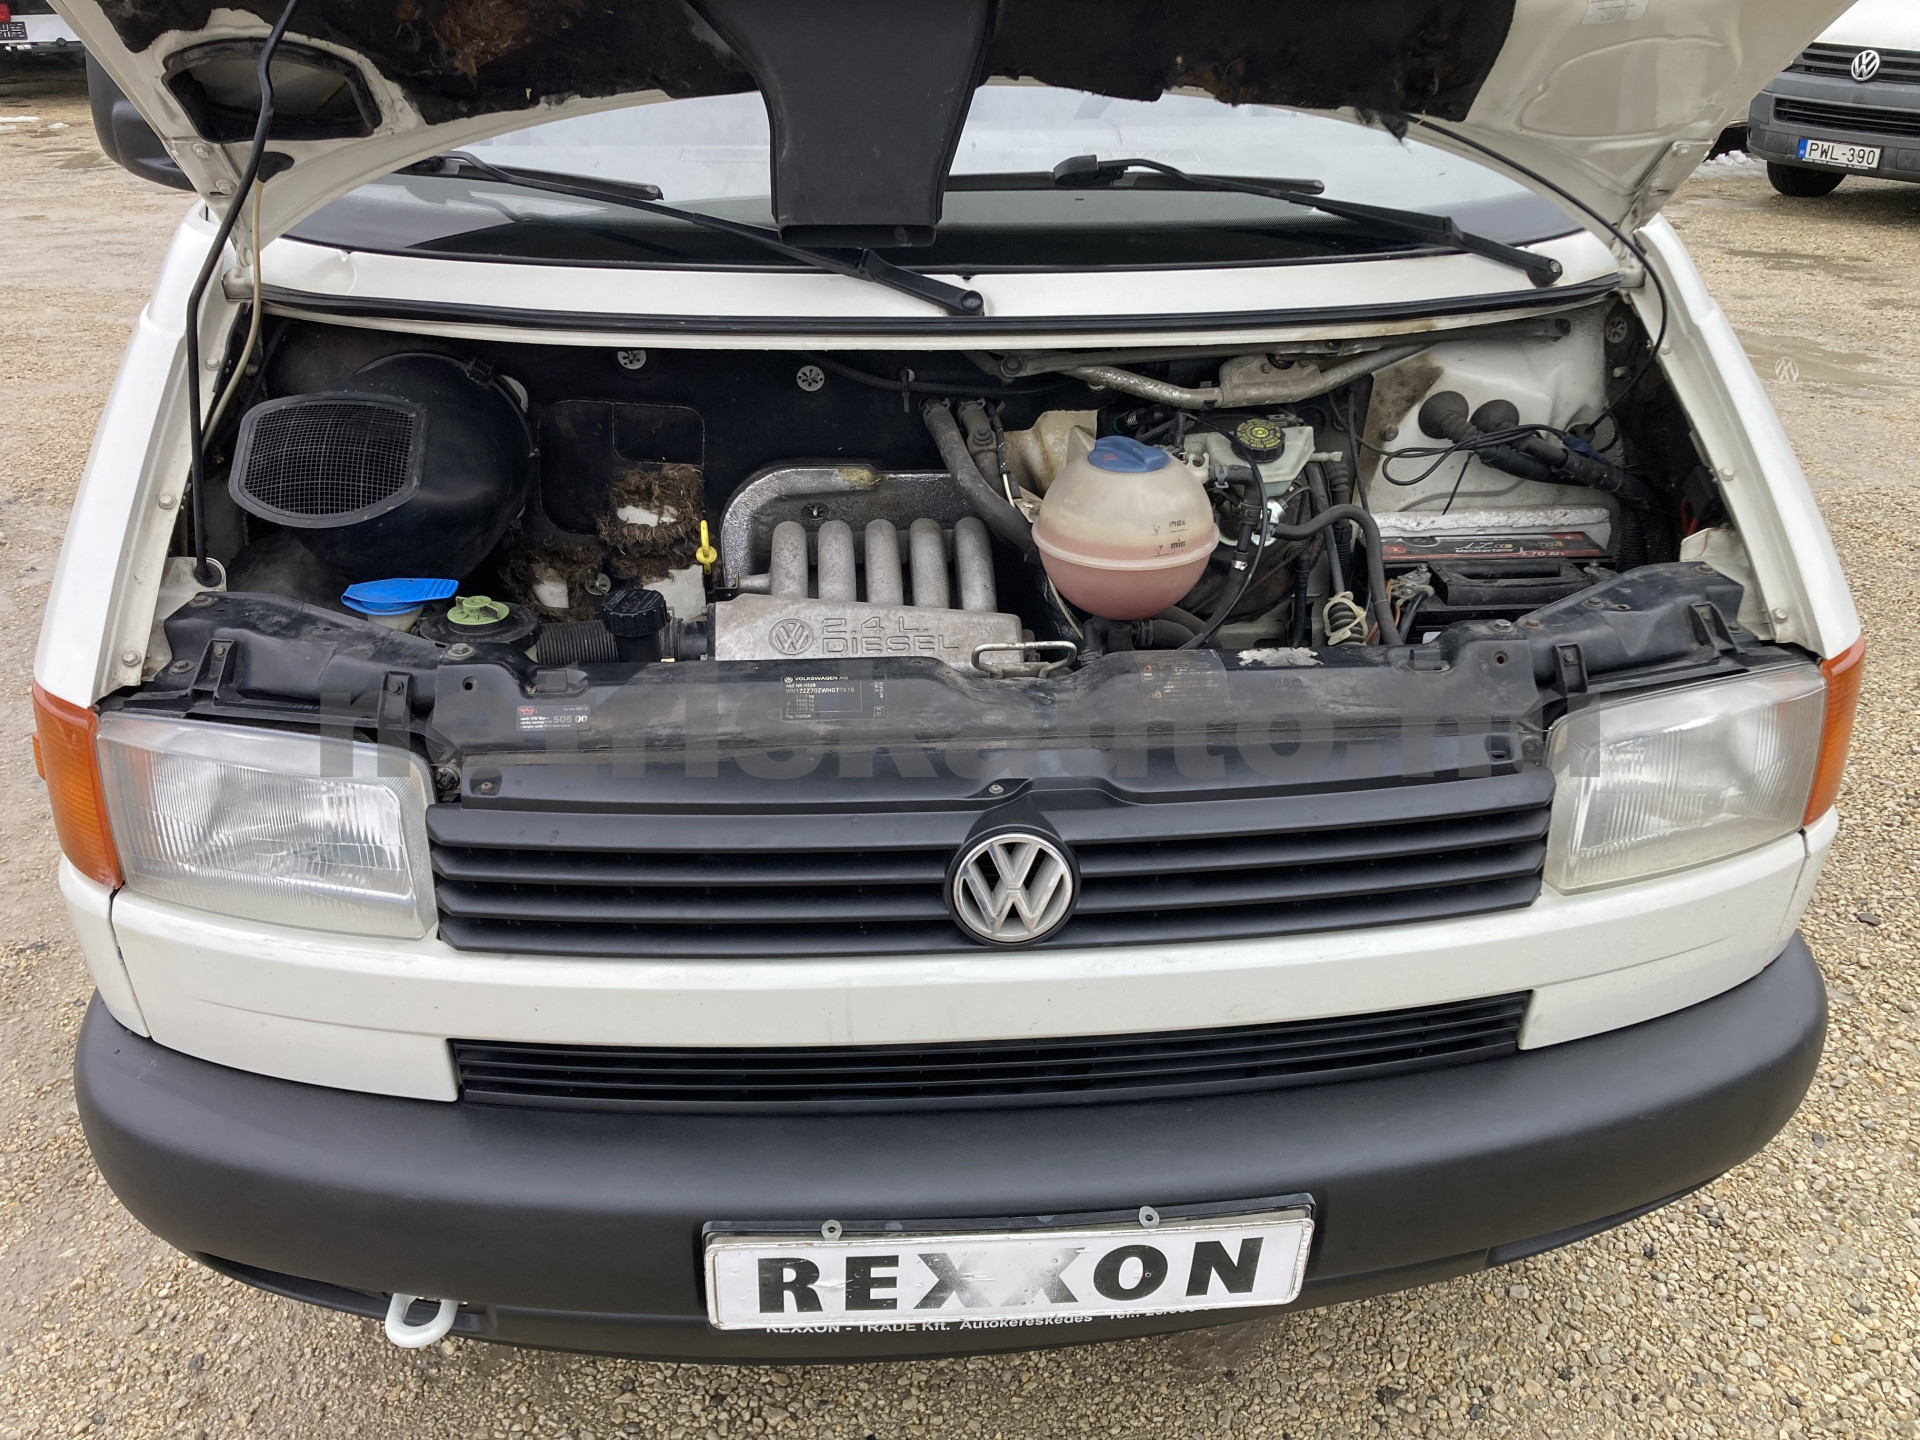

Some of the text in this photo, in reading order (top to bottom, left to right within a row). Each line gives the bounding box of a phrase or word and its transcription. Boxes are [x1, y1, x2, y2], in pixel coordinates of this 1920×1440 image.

[1851, 49, 1880, 81] VW
[1808, 142, 1876, 165] PWL-390
[1168, 519, 1186, 528] max
[1170, 538, 1186, 549] min
[822, 616, 885, 635] 2.4
[553, 715, 588, 723] 505 00
[953, 833, 1073, 943] VW
[758, 1237, 1264, 1314] REXXON
[859, 1323, 917, 1333] TRADE
[921, 1321, 951, 1332] Kft.
